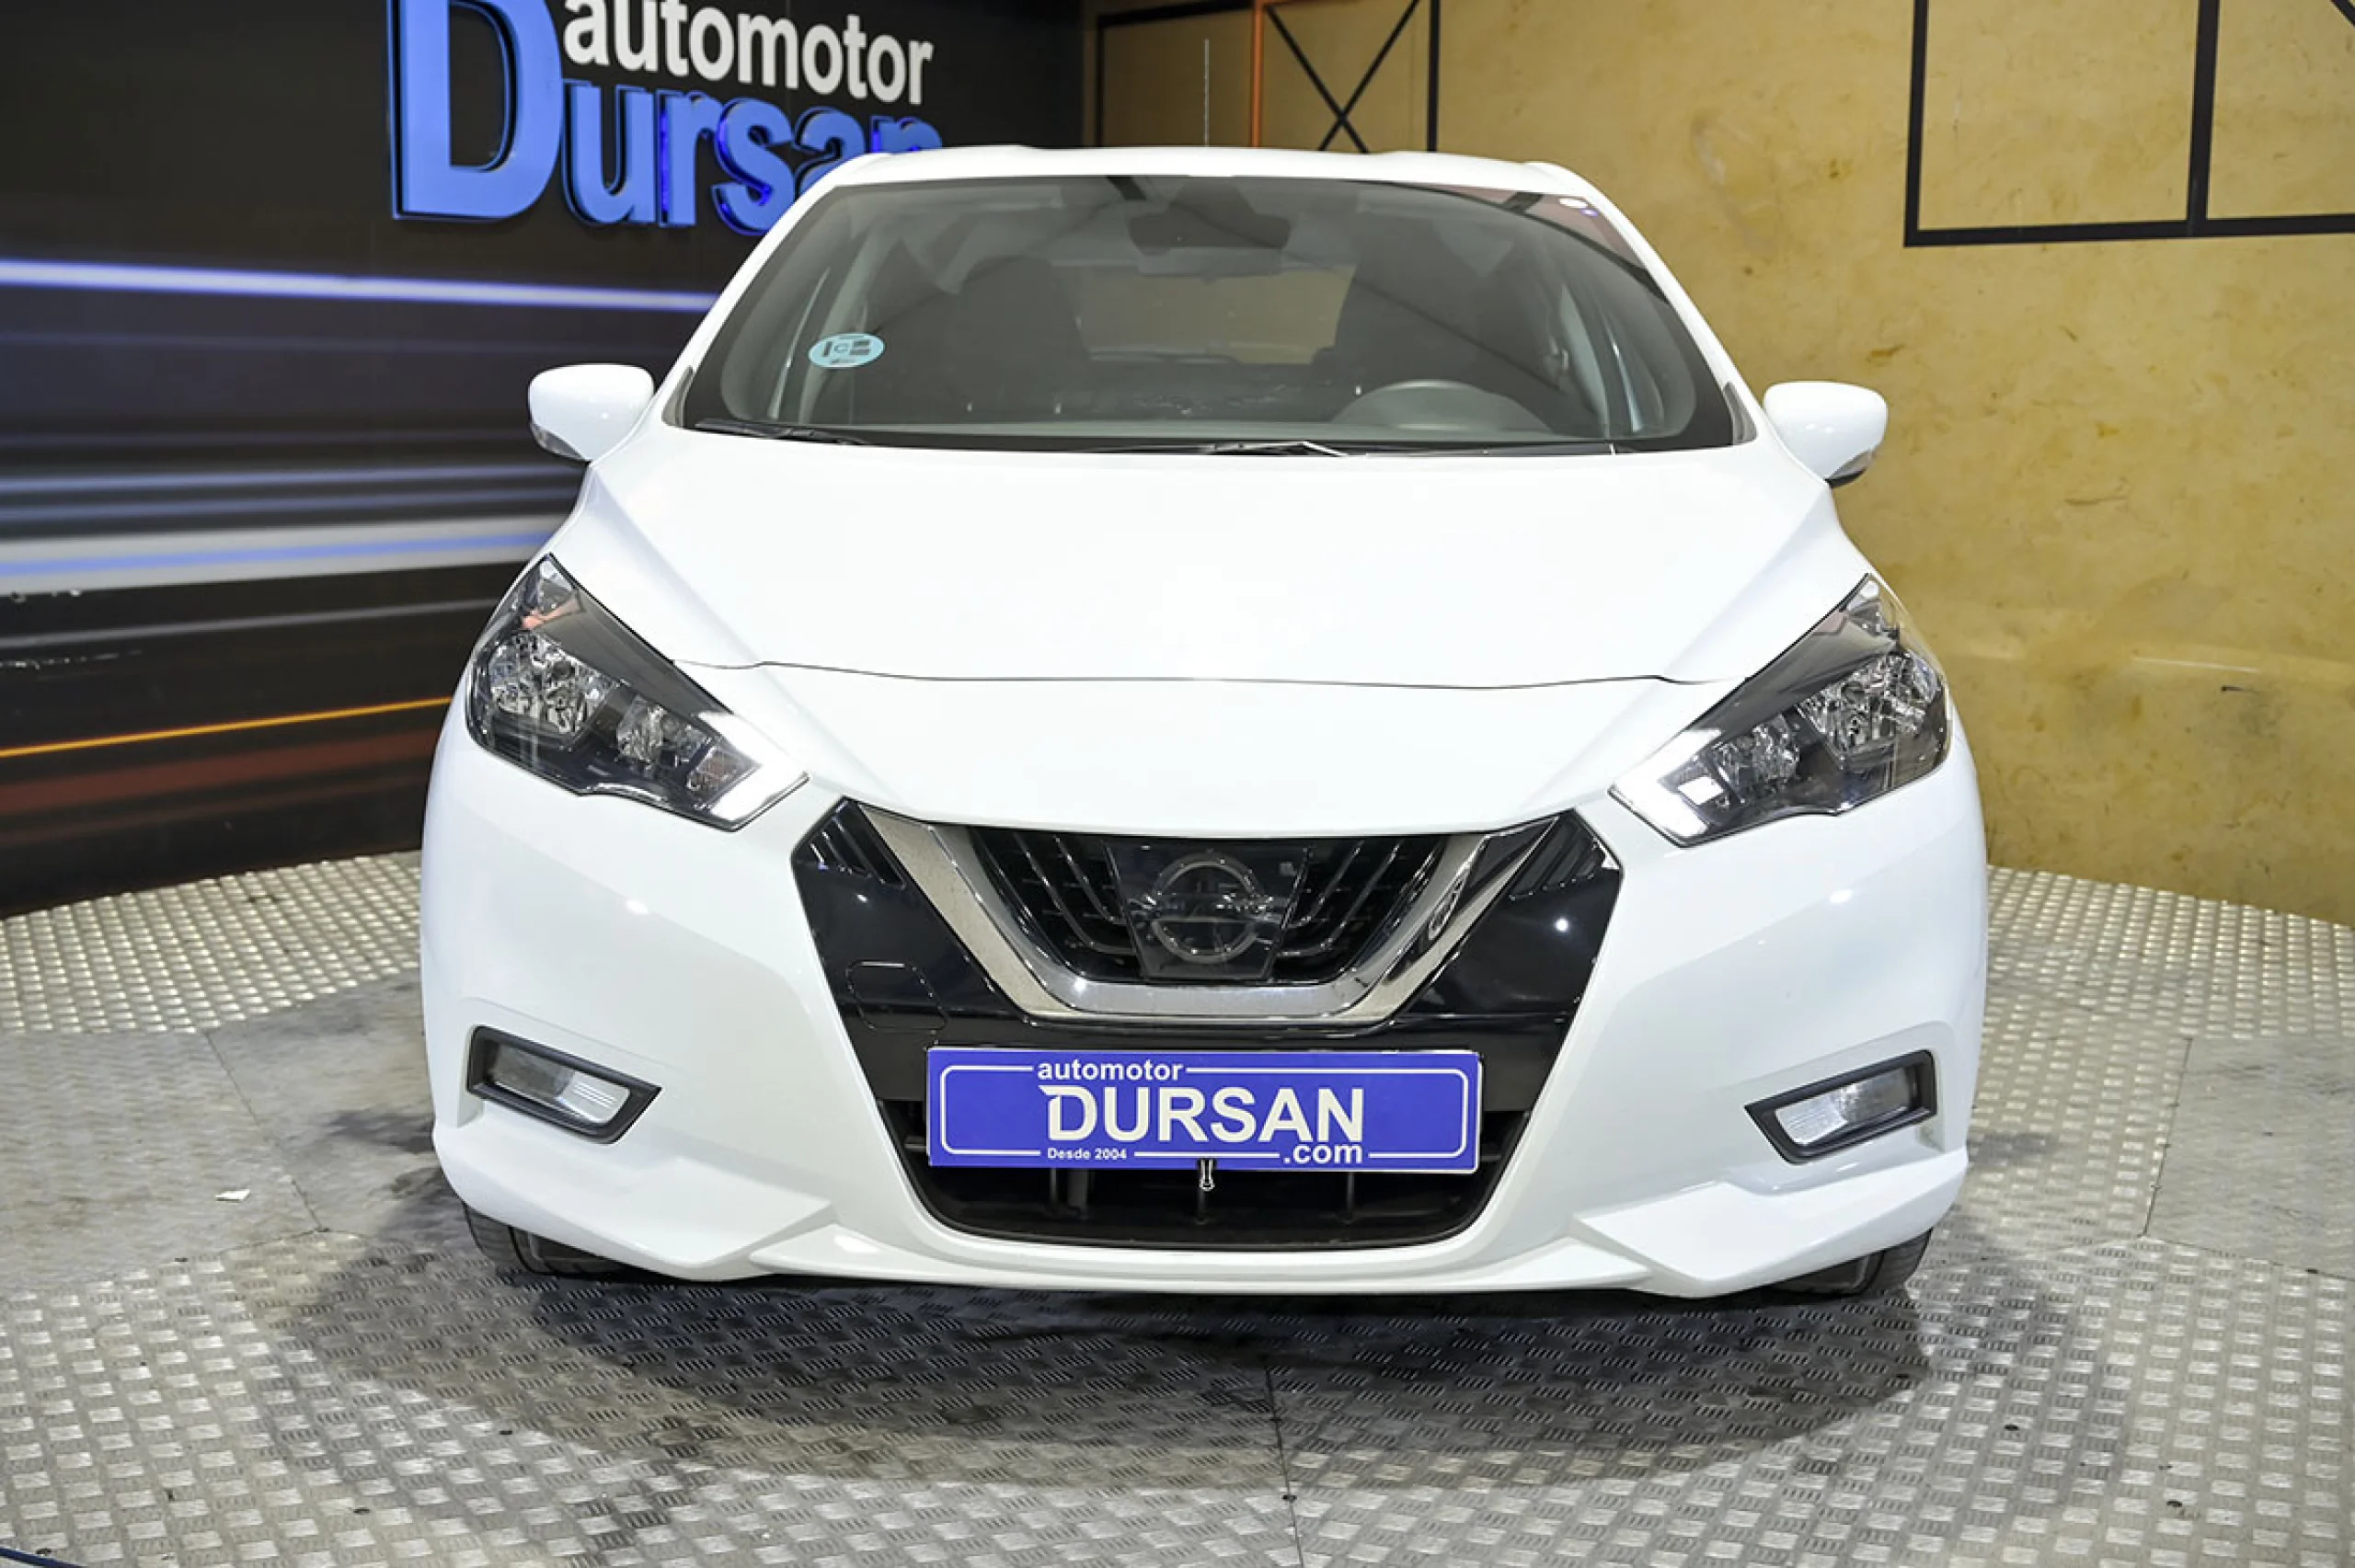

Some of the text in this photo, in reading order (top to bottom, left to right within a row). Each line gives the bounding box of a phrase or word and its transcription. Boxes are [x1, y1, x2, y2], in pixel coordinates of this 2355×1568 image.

[564, 0, 935, 105] automotor
[1038, 1059, 1184, 1081] automotor
[1038, 1085, 1363, 1142] DURSAN
[1047, 1148, 1127, 1160] Desde 2004
[1283, 1143, 1363, 1164] .com
